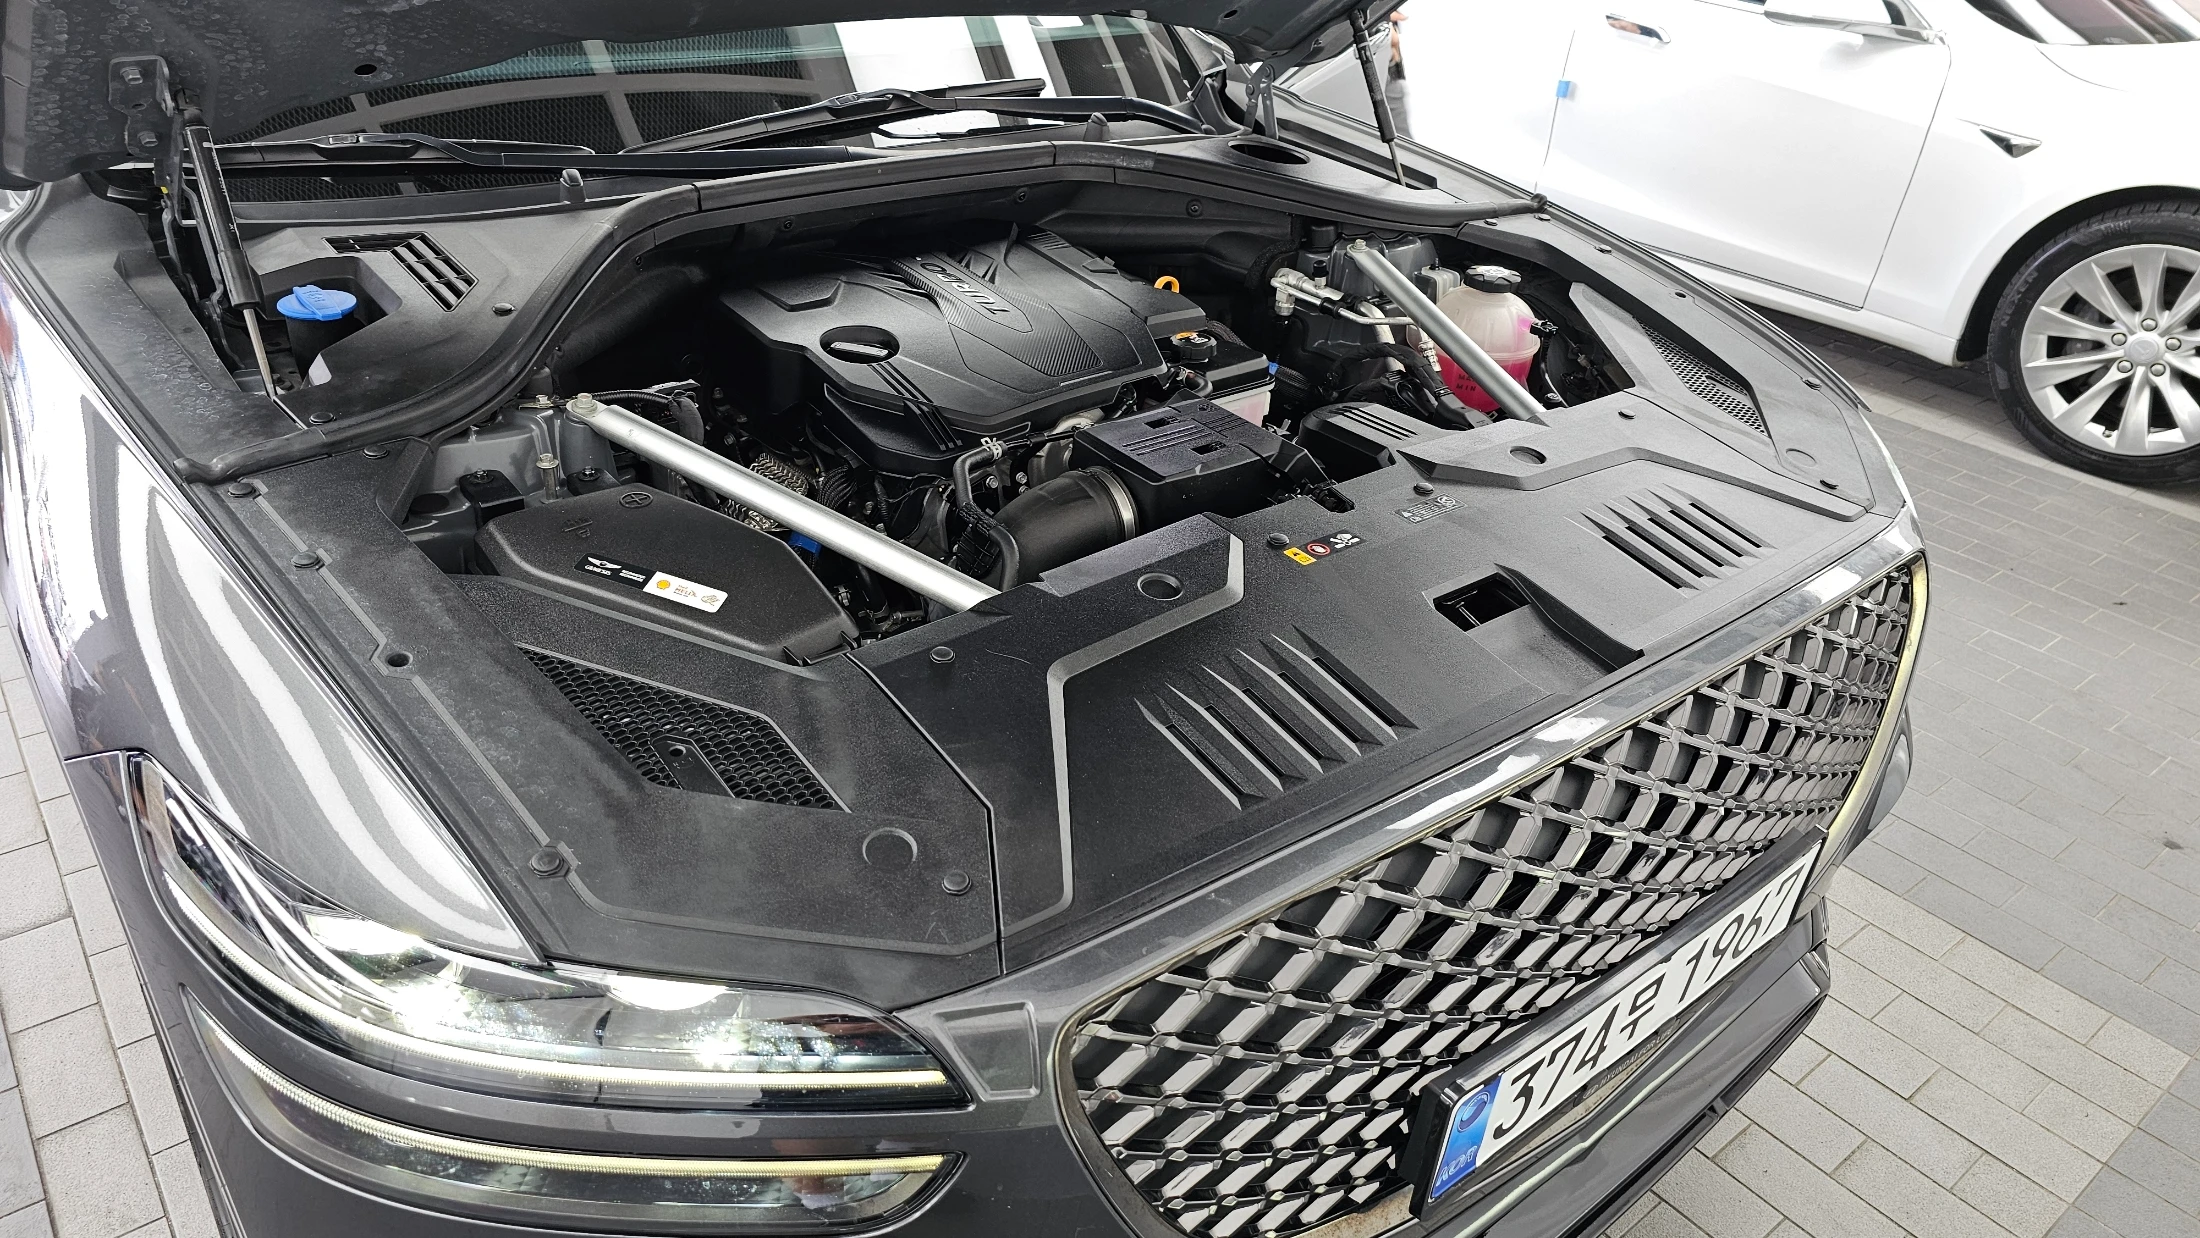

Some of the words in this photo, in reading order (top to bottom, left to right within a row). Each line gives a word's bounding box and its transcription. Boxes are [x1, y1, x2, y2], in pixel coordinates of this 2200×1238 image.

[920, 262, 1010, 315] TURBO
[2001, 269, 2039, 327] NEXEN
[1456, 383, 1477, 391] MIN
[1677, 861, 1807, 1005] 1967
